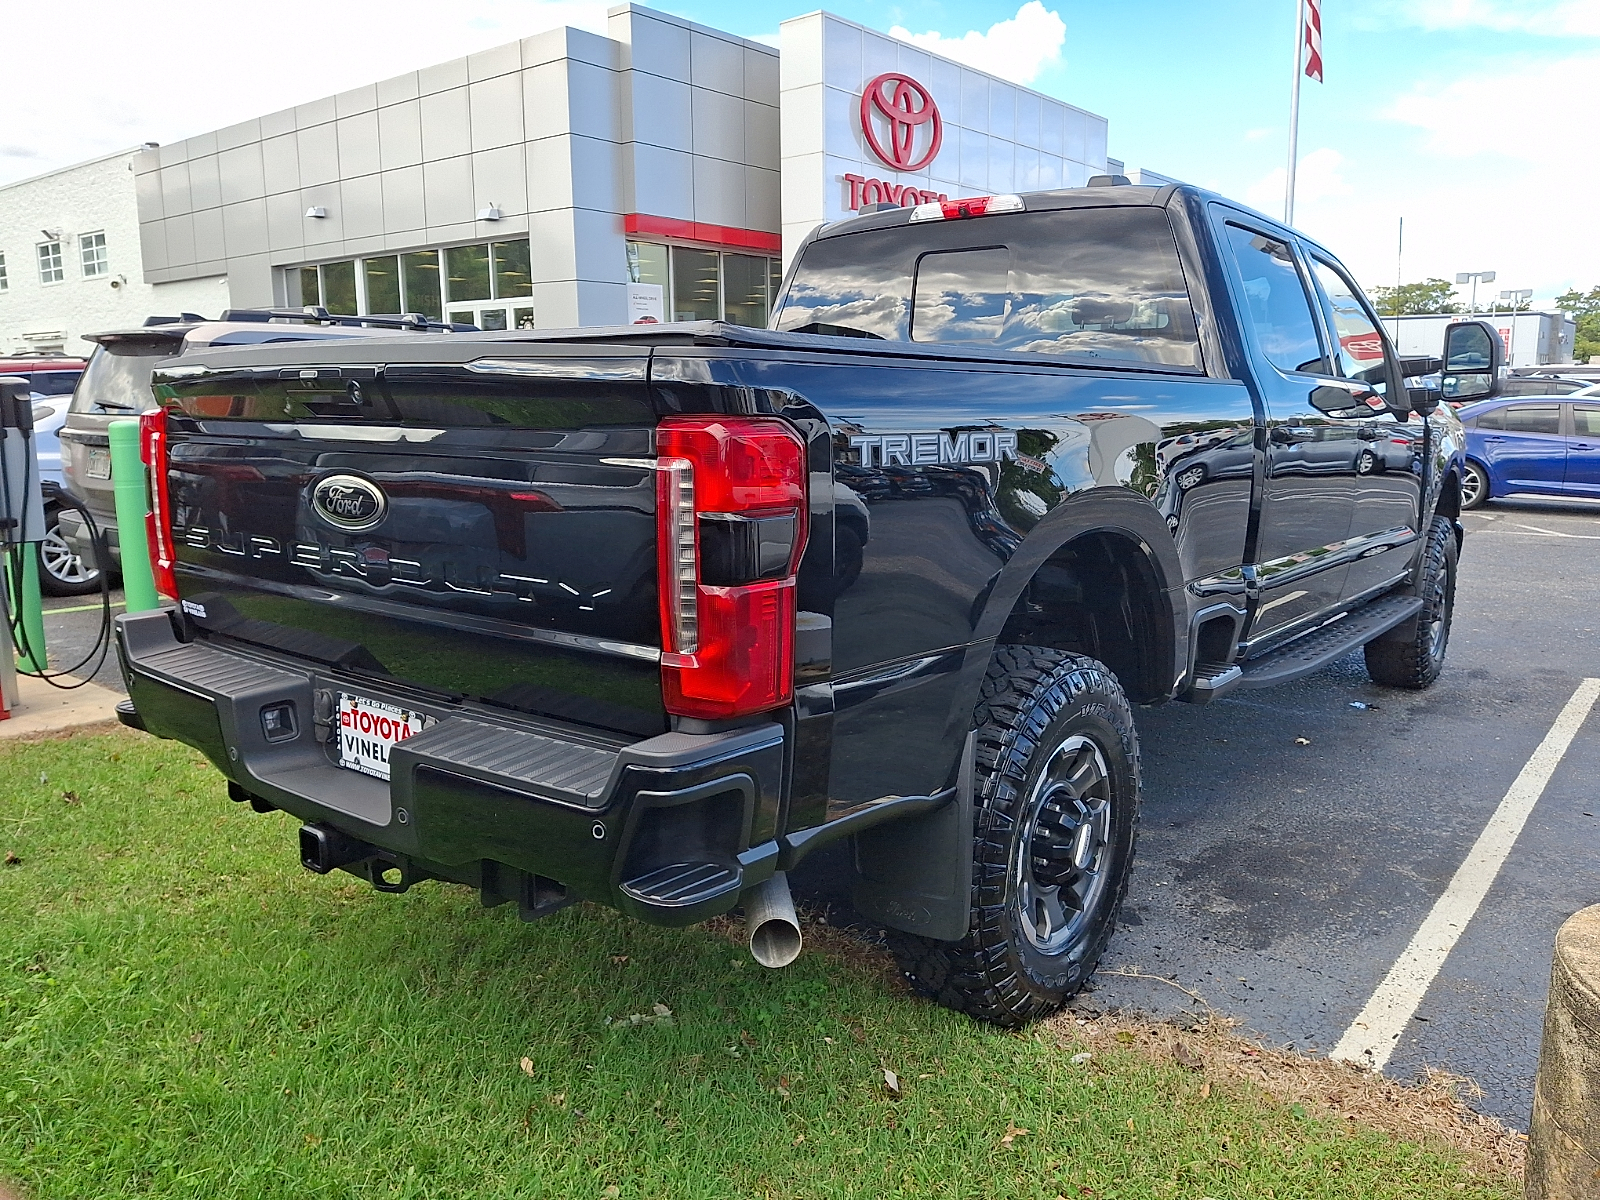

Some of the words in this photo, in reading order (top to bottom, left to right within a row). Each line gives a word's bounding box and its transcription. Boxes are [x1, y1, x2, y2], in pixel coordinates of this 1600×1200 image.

[850, 431, 1018, 468] TREMOR
[326, 485, 363, 515] Ford
[186, 526, 368, 577] SUPER
[350, 708, 411, 742] TOYOTA
[380, 703, 402, 714] Places
